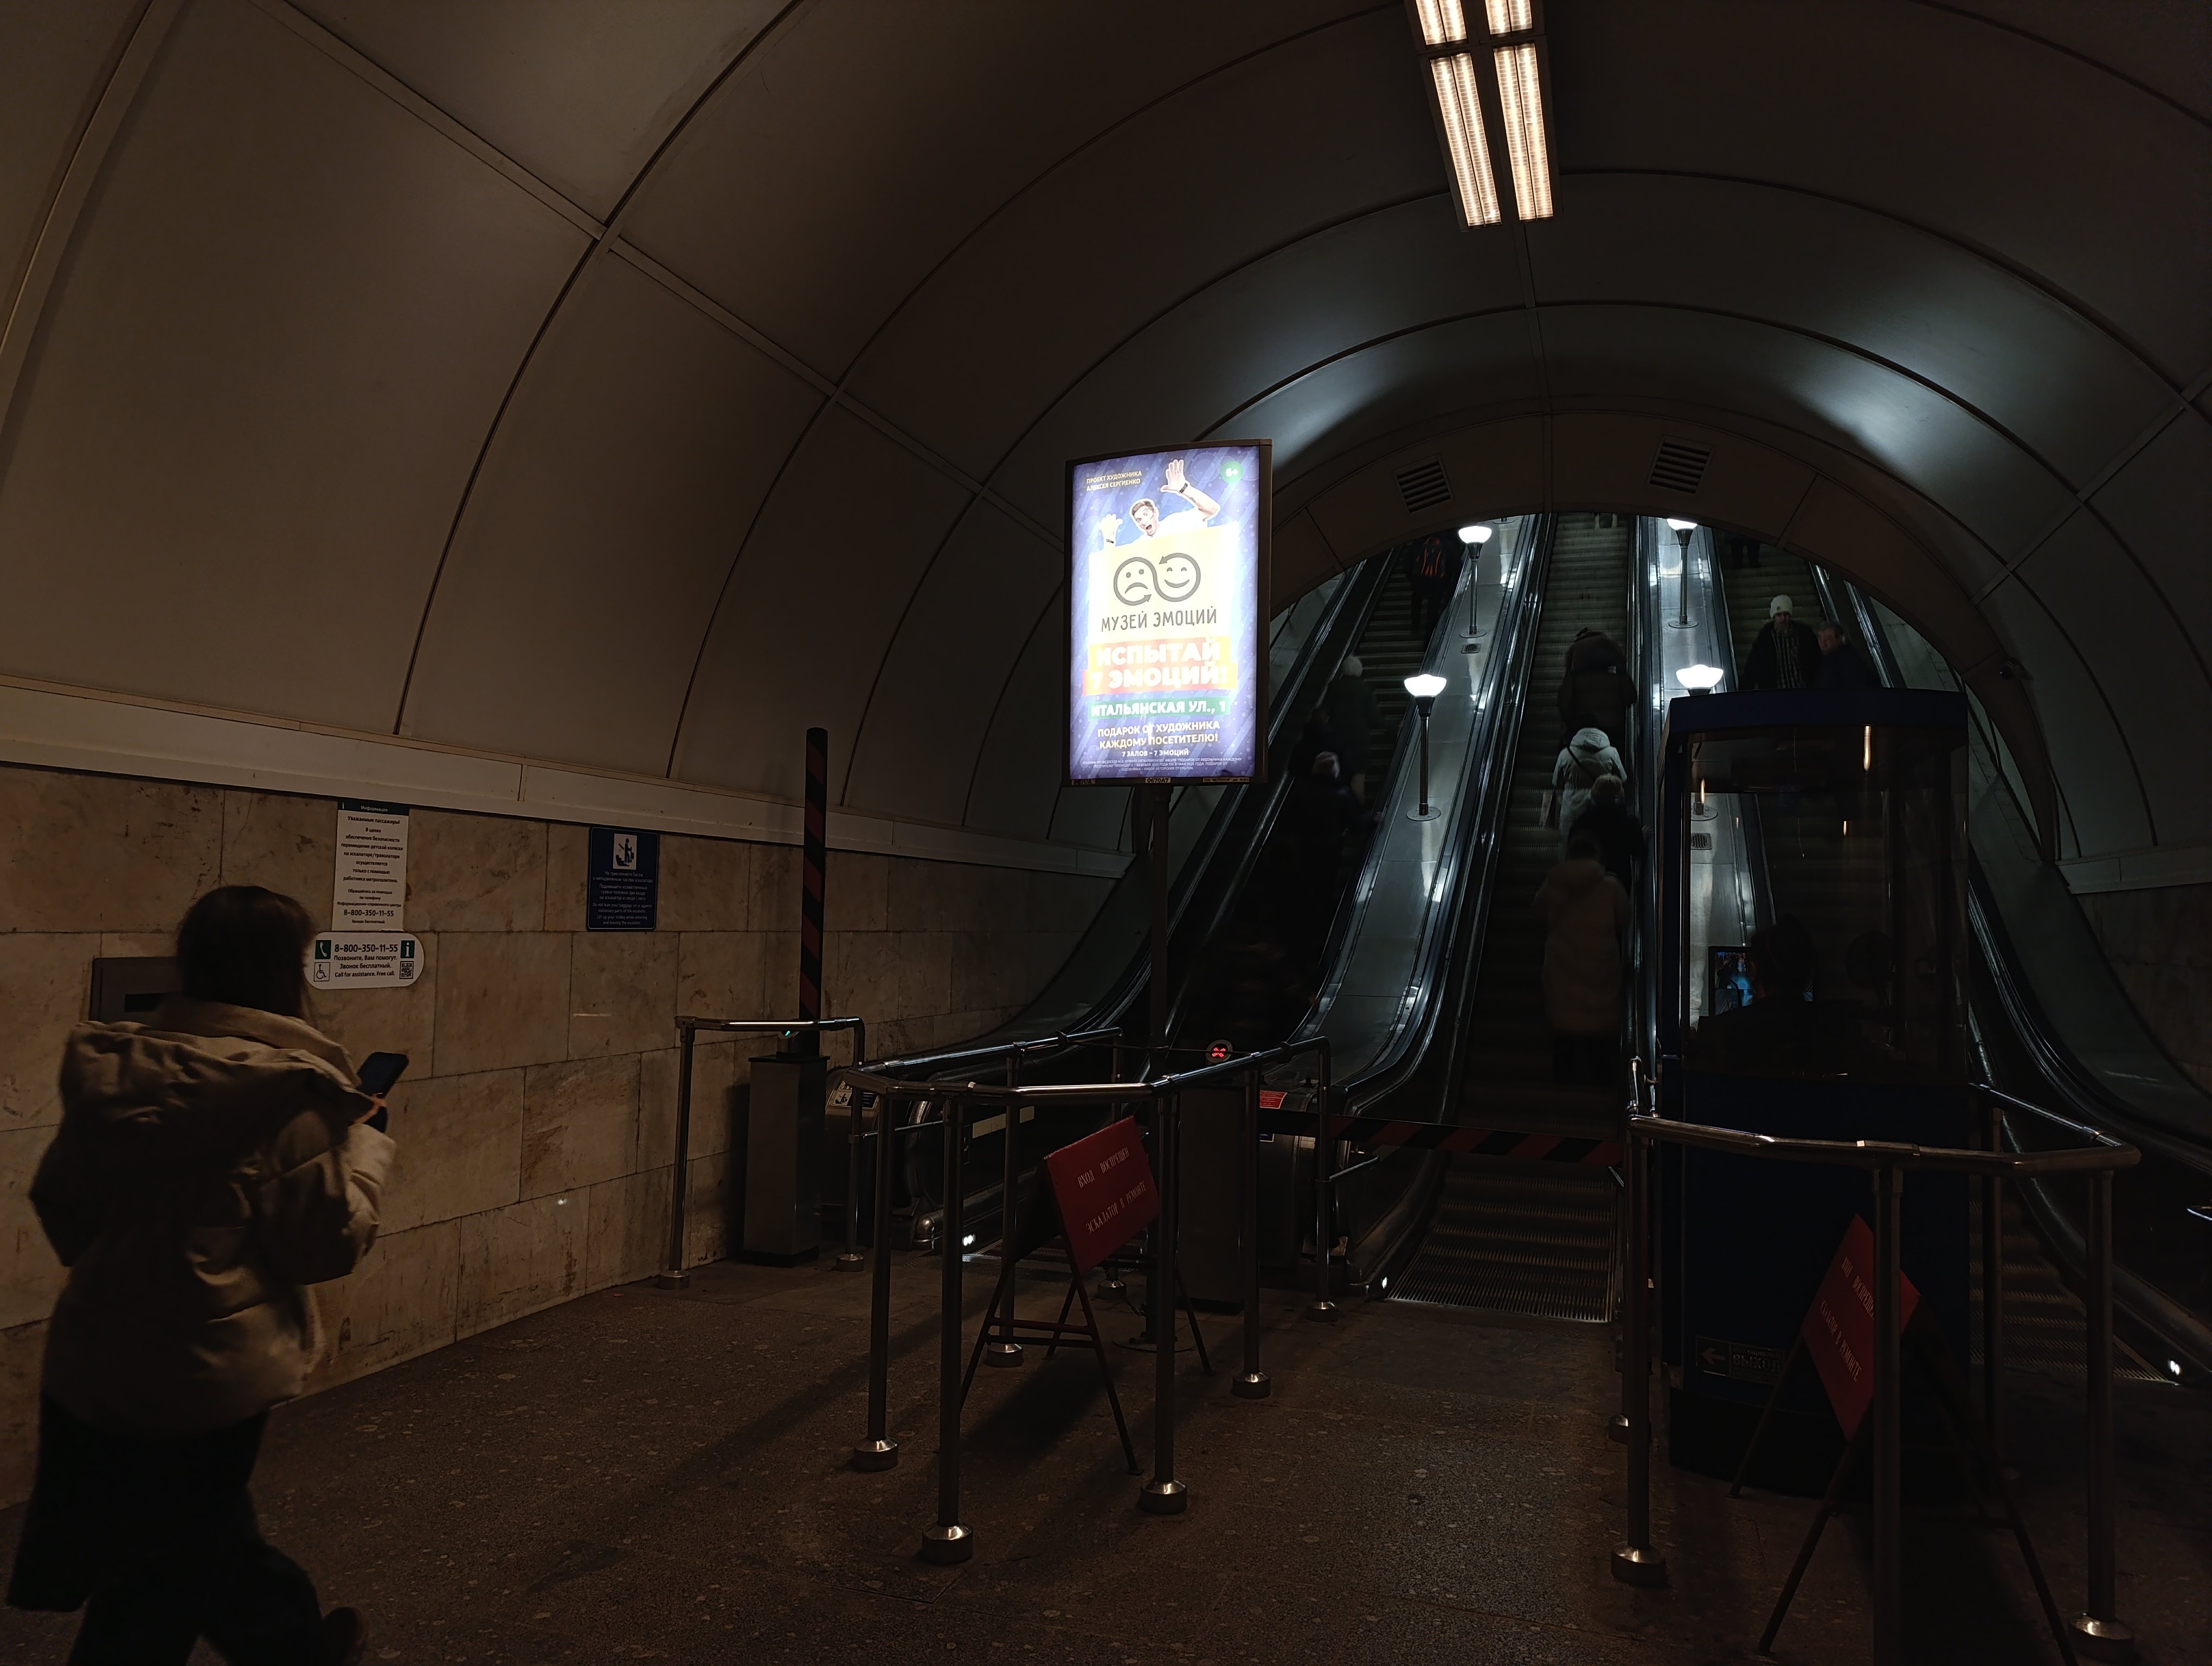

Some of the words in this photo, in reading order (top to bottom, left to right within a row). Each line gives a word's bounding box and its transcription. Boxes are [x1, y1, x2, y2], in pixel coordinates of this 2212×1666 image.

[1086, 475, 1106, 484] ПРОЕКТ
[1107, 471, 1142, 480] ХУДОЖНИКА
[1086, 482, 1109, 491] АЛЕКСЕЯ
[1109, 478, 1141, 487] СЕРГИЕНКО
[1101, 611, 1147, 632] МУЗЕЙ
[1153, 606, 1217, 627] ЭМОЦИЙ
[1097, 637, 1220, 667] ИСПЫТАЙ
[1090, 670, 1103, 689] 7
[1108, 661, 1227, 689] ЭМОЦИЙ!
[1091, 701, 1185, 717] ИТАЛЬЯНСКАЯ
[1188, 701, 1215, 714] УЛ.,
[1219, 700, 1226, 713] 1
[1097, 725, 1140, 738] ПОДАРОК
[1142, 723, 1155, 734] ОТ
[1156, 721, 1220, 733] ХУДОЖНИКА
[1099, 736, 1146, 749] КАЖДОМУ
[1149, 734, 1218, 745] ПОСЕТИТЕЛЮ!
[1159, 748, 1189, 756] ЭМОЦИЙ
[1077, 1169, 1096, 1189] ВХОД
[1099, 1146, 1130, 1174] ВОСПРЕЩЕН
[1085, 1202, 1119, 1234] ЭСКАЛАТОР
[1120, 1197, 1125, 1209] В
[1126, 1180, 1147, 1204] РЕМОНТЕ
